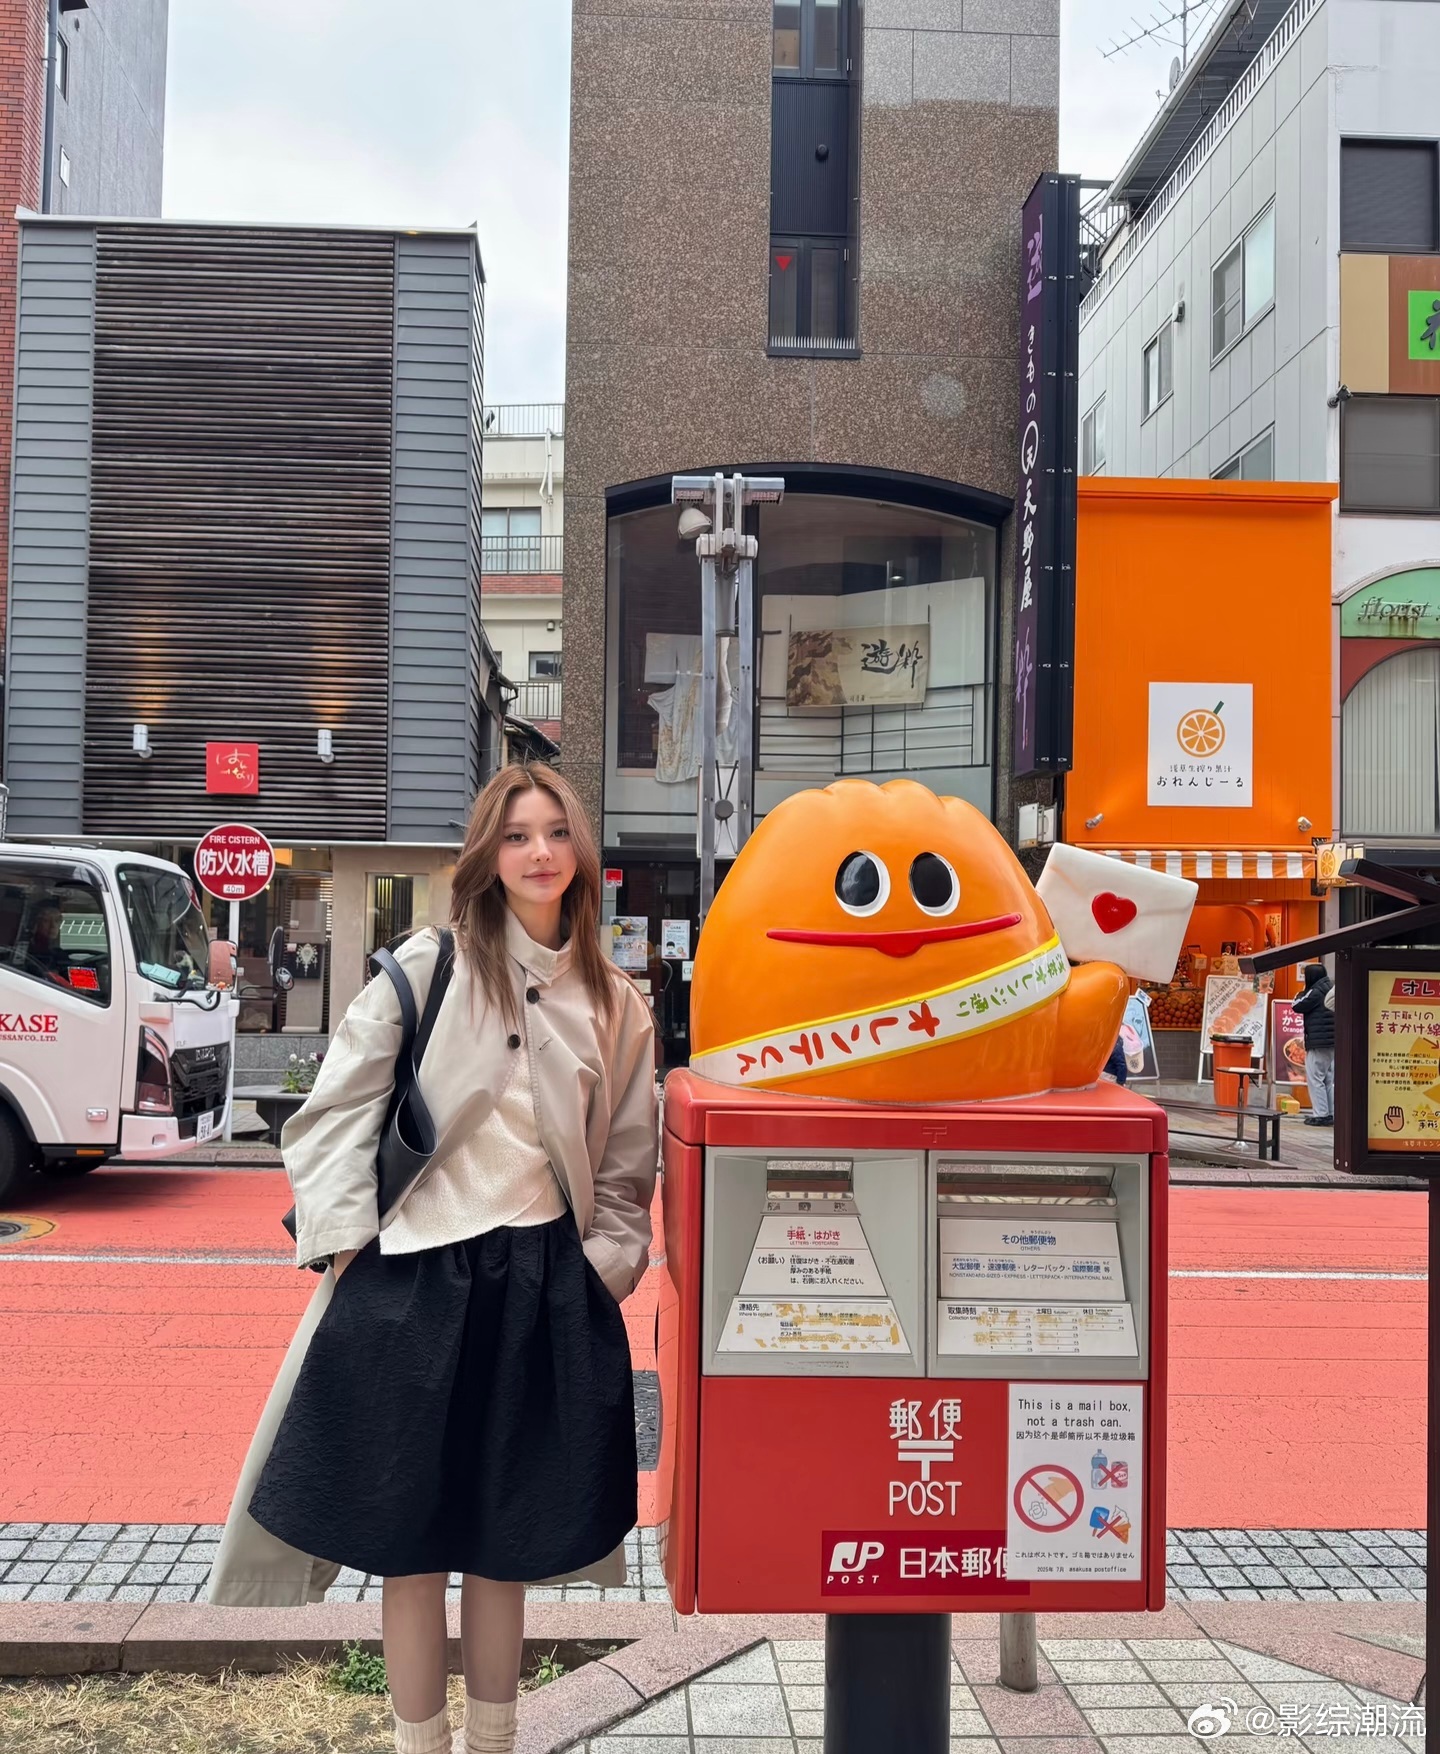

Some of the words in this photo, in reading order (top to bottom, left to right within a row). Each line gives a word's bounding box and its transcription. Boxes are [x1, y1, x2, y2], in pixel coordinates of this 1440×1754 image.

[1361, 596, 1432, 619] florist
[1156, 775, 1244, 788] おれんじーる
[209, 835, 226, 844] FIRE
[228, 835, 261, 845] CISTERN
[199, 849, 270, 877] 防火水槽
[1401, 979, 1440, 996] オレ
[1381, 1010, 1434, 1020] 天下取りの
[736, 1000, 941, 1076] オレンテくん
[787, 1230, 840, 1240] 手紙・はがき
[1002, 1234, 1057, 1246] その他郵便物
[790, 1267, 832, 1275] 厚みのある手紙
[739, 1303, 760, 1311] 連絡先
[947, 1306, 977, 1315] 取集時刻
[1018, 1398, 1043, 1410] This
[1050, 1399, 1061, 1411] is
[1067, 1402, 1073, 1411] a
[1079, 1400, 1102, 1411] mail
[1109, 1400, 1131, 1412] box,
[889, 1398, 963, 1440] 郵便
[1027, 1417, 1046, 1427] not
[1052, 1418, 1058, 1427] a
[1064, 1417, 1095, 1427] trash
[1100, 1418, 1122, 1428] can.
[1016, 1430, 1136, 1441] 因为这个是邮筒所以不是垃圾箱
[889, 1481, 963, 1516] POST
[829, 1541, 885, 1572] JP
[826, 1575, 880, 1584] POST
